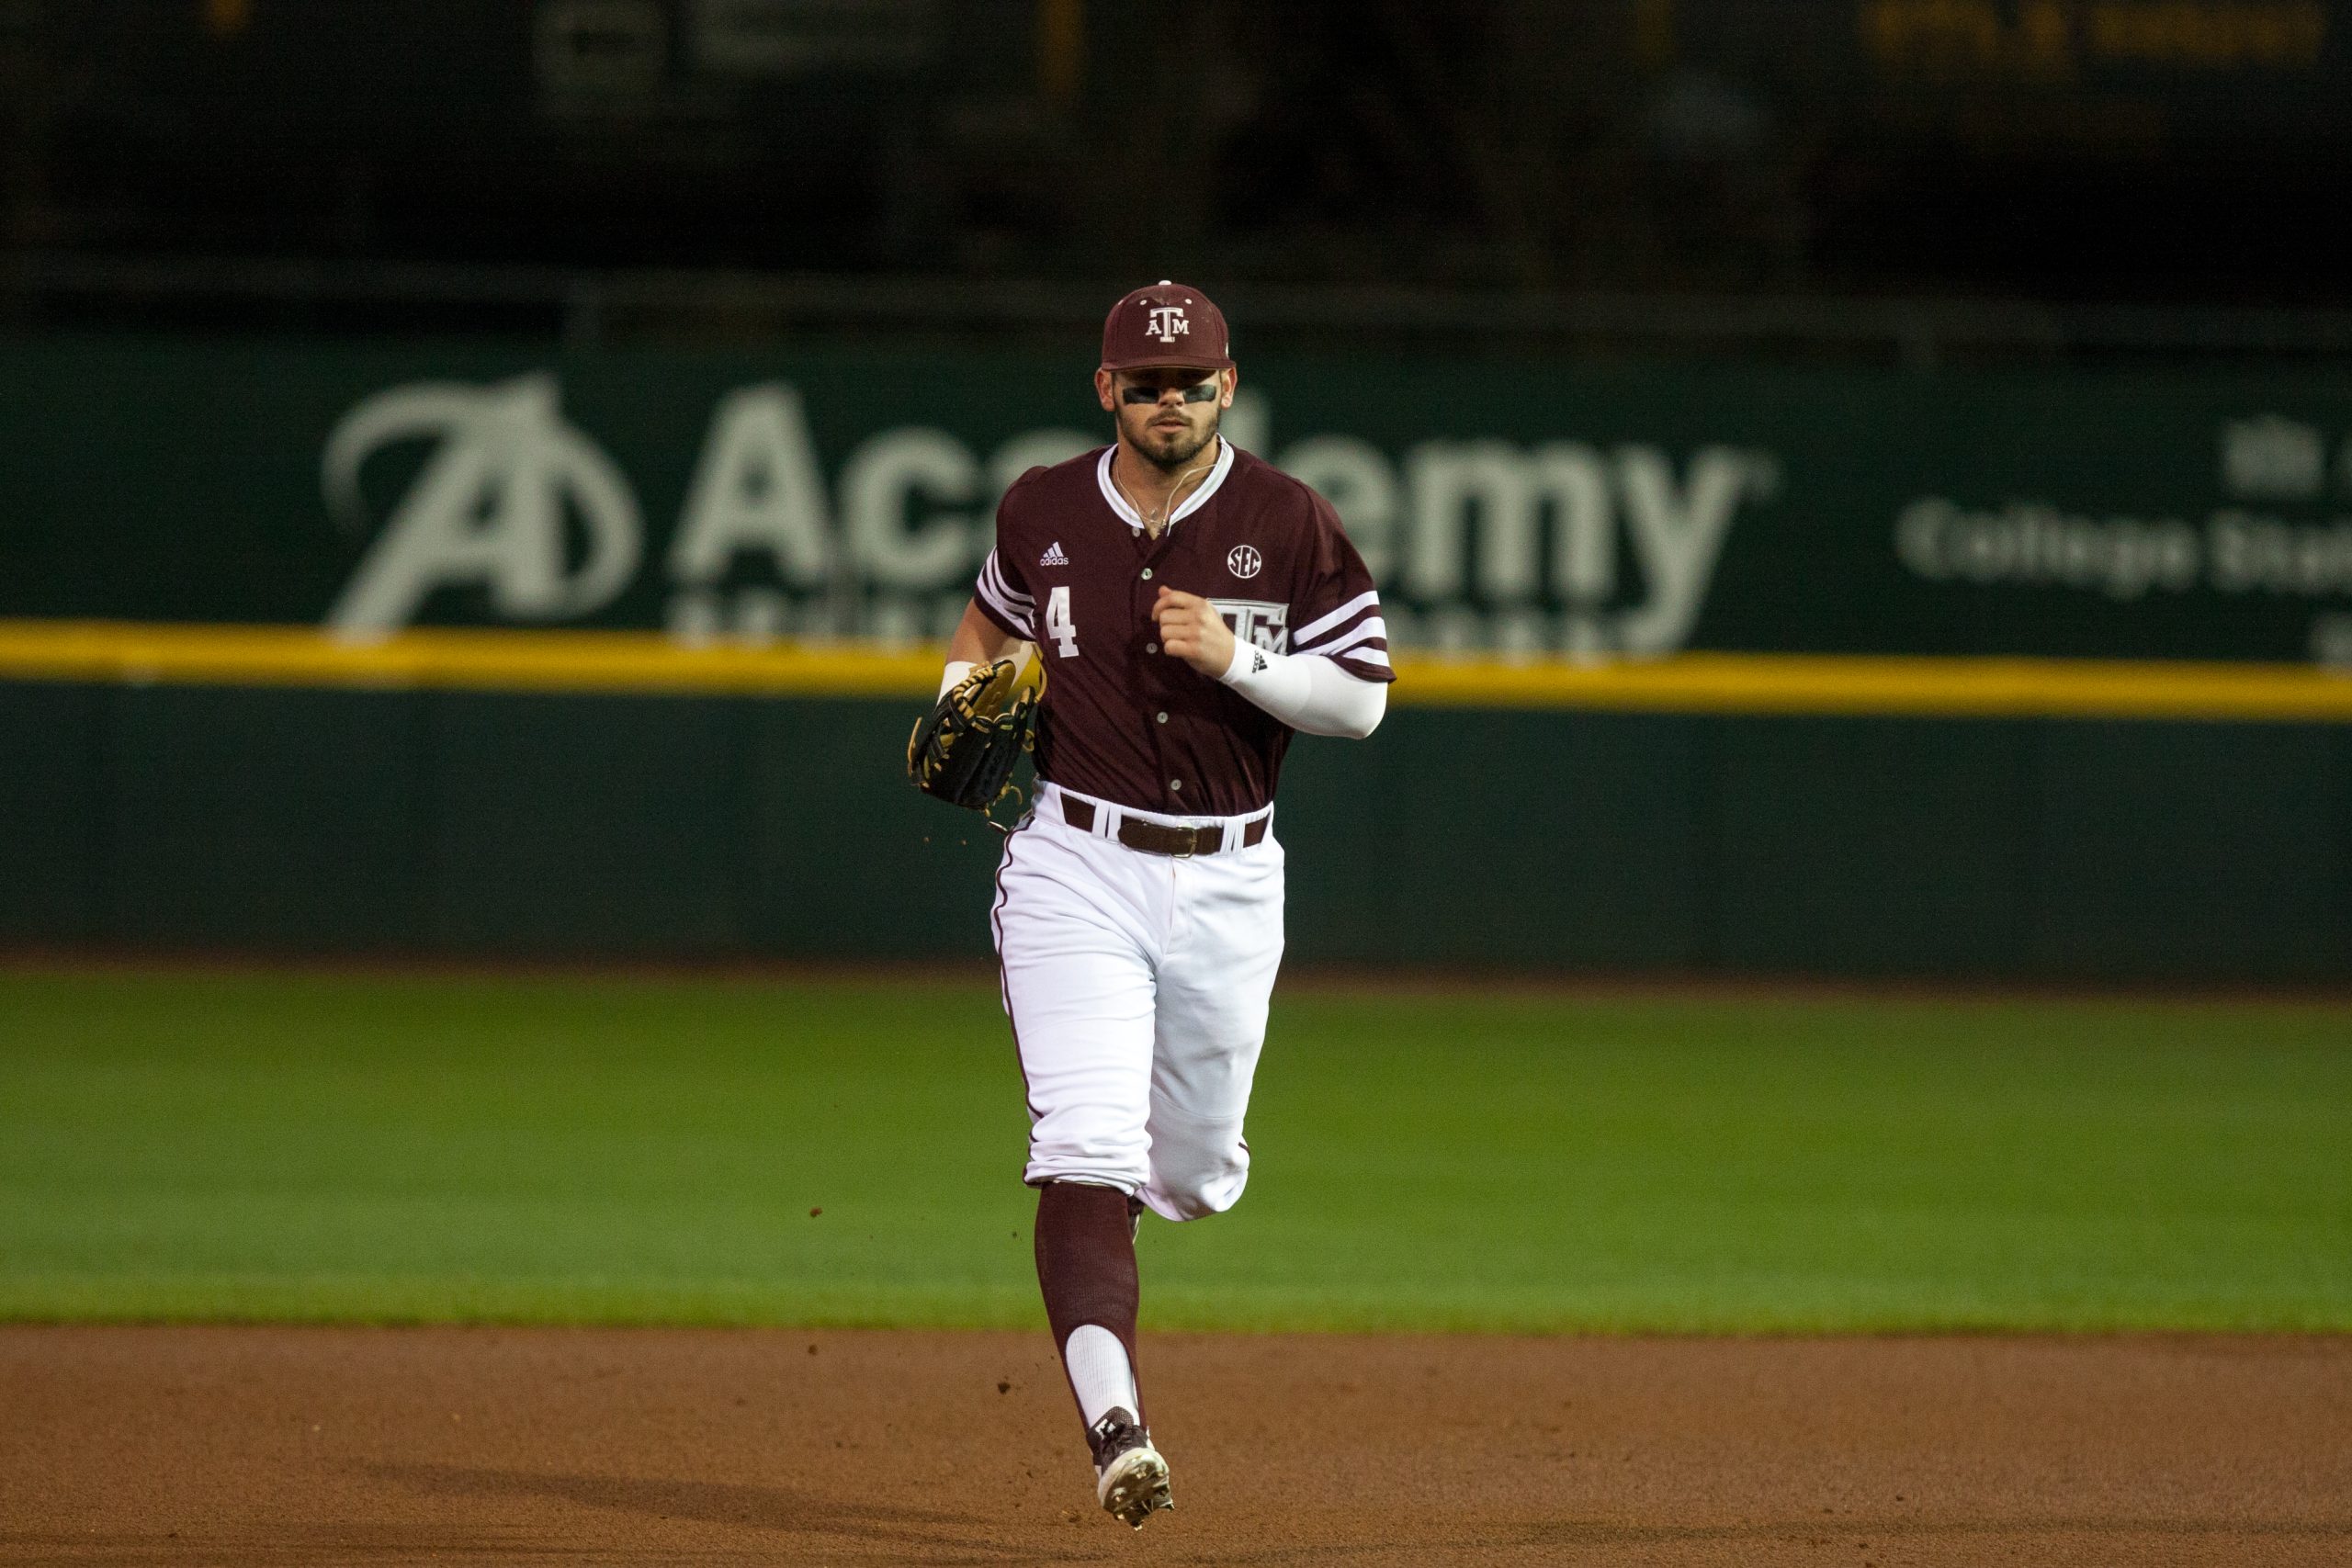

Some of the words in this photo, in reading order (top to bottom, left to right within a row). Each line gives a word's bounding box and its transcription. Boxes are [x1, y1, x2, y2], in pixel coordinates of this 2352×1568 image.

[666, 379, 1748, 660] Acemy
[1040, 557, 1069, 566] adidas
[1228, 546, 1261, 578] SEC
[1046, 586, 1080, 658] 4
